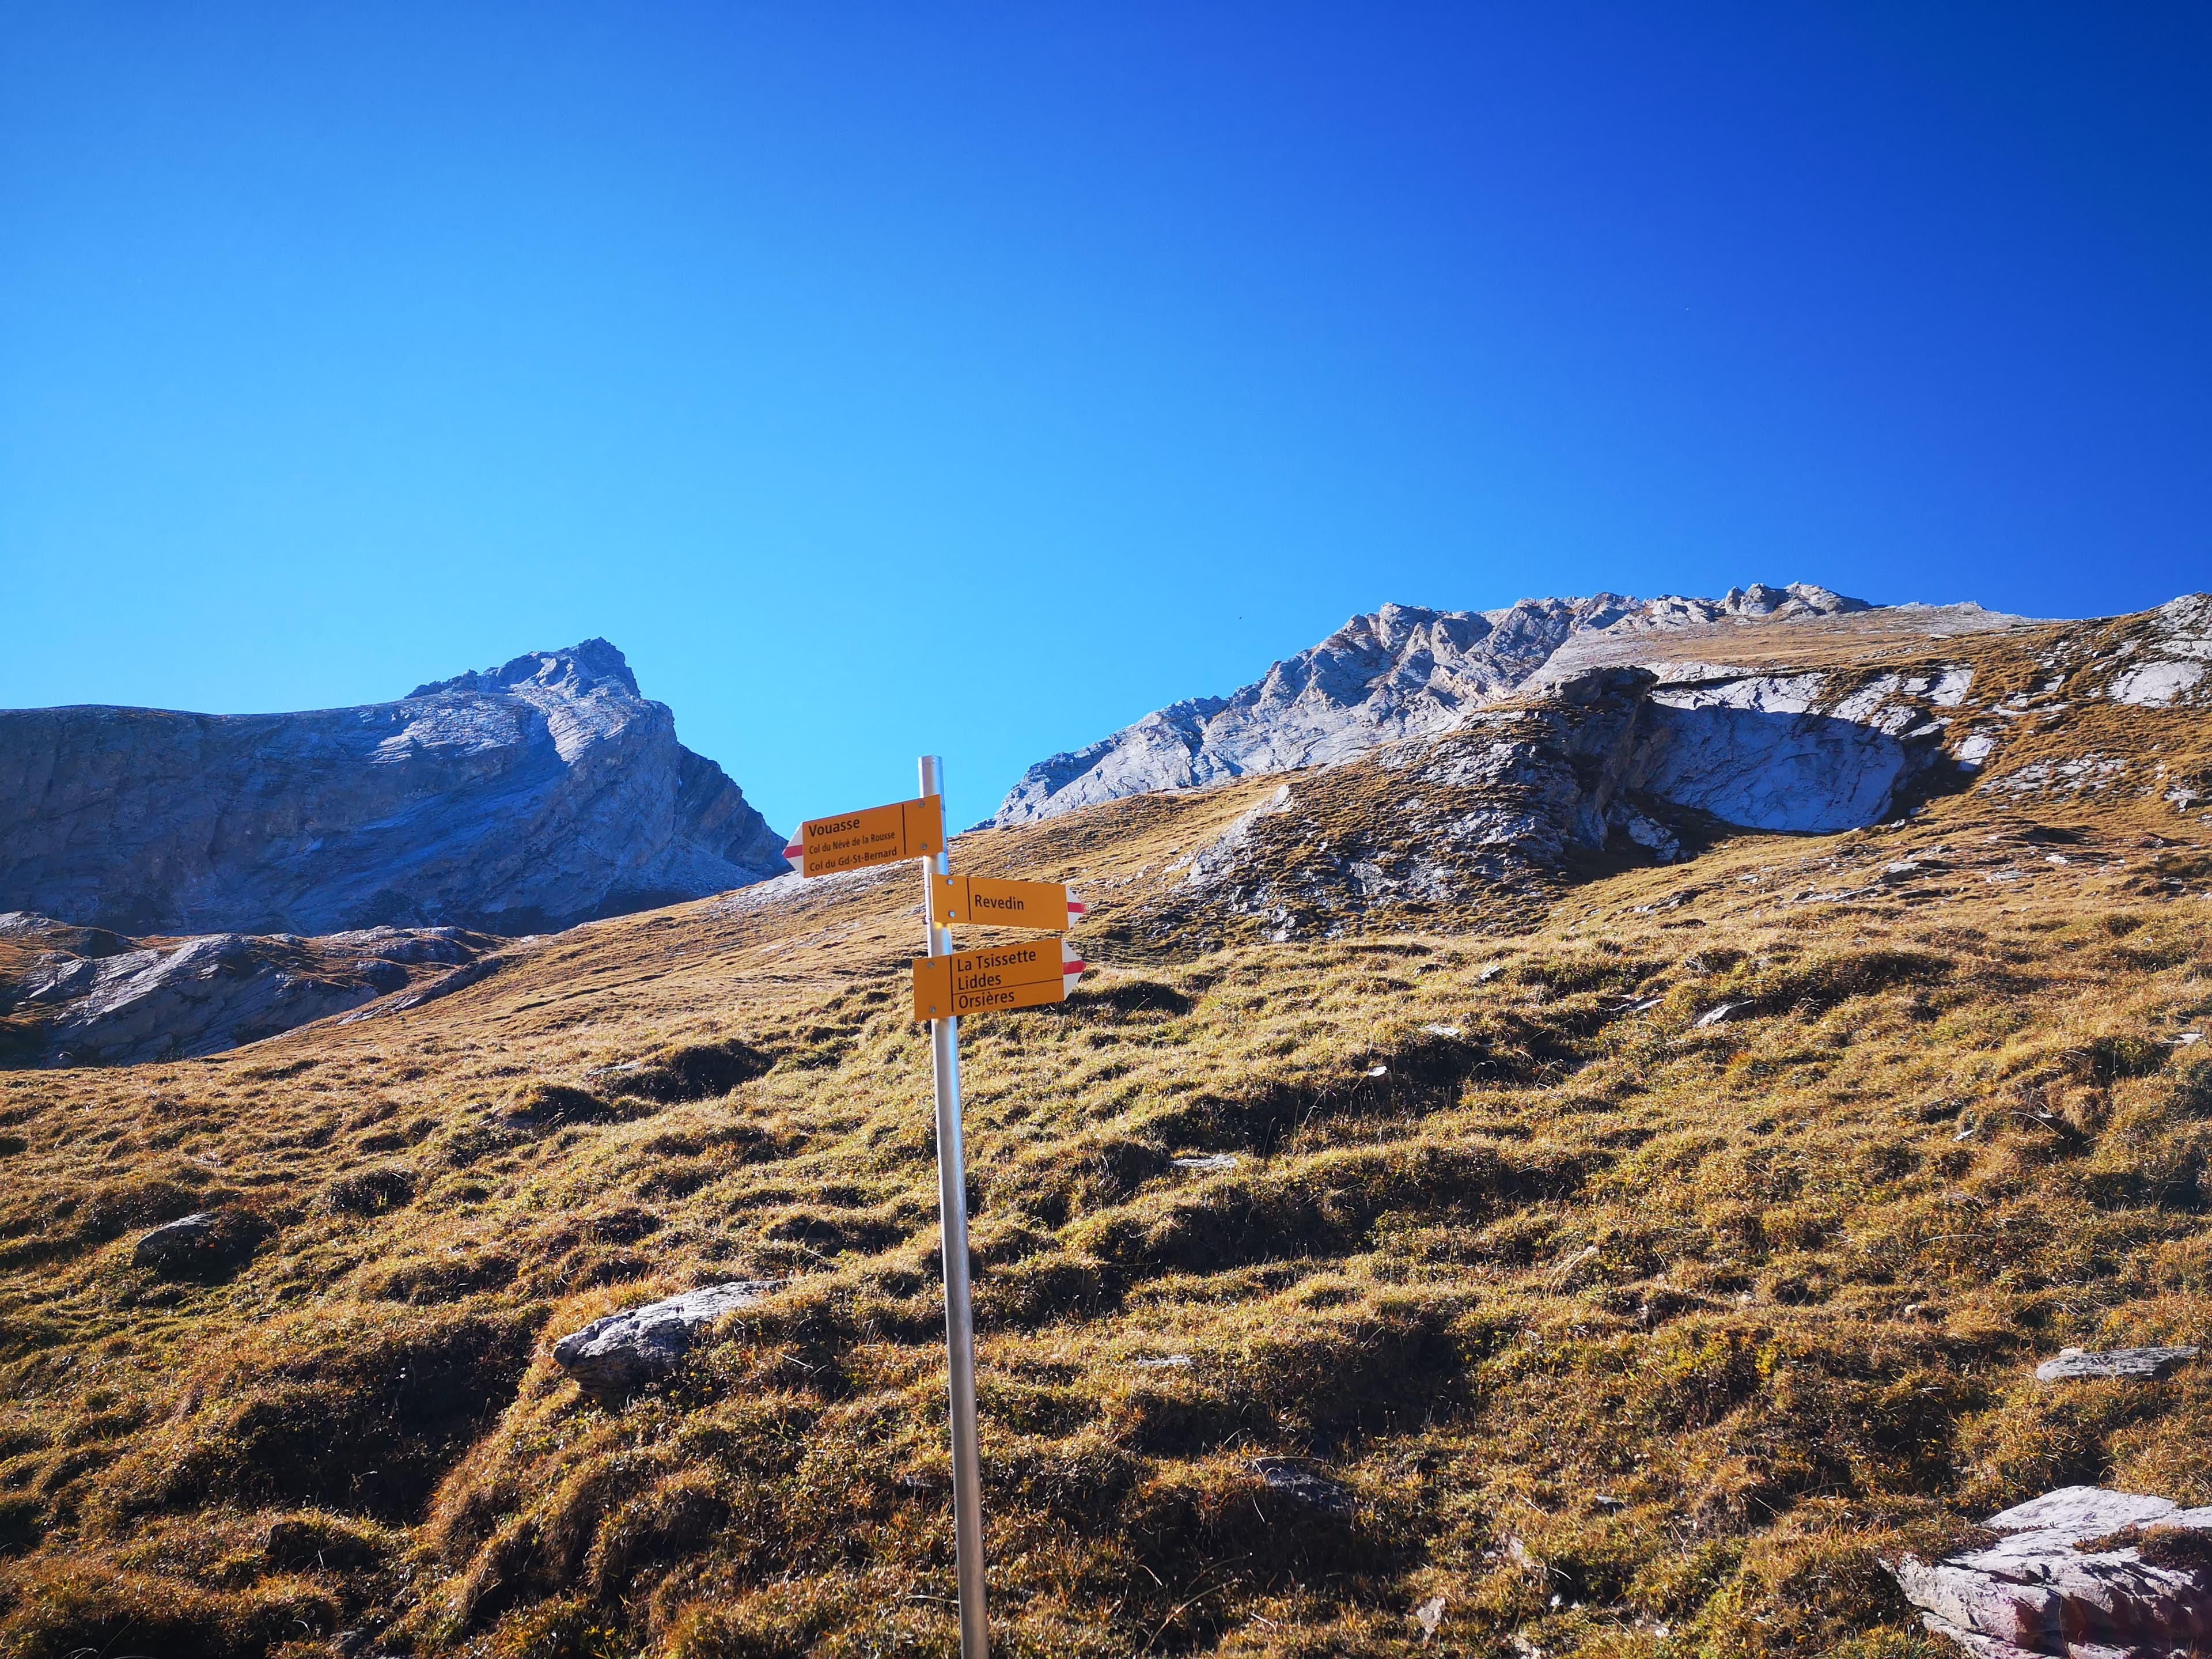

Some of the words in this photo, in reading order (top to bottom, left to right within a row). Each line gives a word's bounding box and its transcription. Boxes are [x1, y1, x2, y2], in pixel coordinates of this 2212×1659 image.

[809, 818, 860, 837] Vouasse
[809, 844, 820, 854] Col
[822, 842, 831, 852] du
[833, 839, 850, 849] Névé
[852, 837, 860, 846] de
[862, 835, 869, 844] la
[871, 831, 895, 842] Rousse
[810, 861, 823, 871] Col
[825, 859, 835, 869] du
[975, 895, 1024, 910] Revedin
[957, 959, 972, 972] La
[976, 949, 1036, 969] Tsissette
[958, 974, 1001, 990] Liddes
[959, 990, 1014, 1009] Orsières
